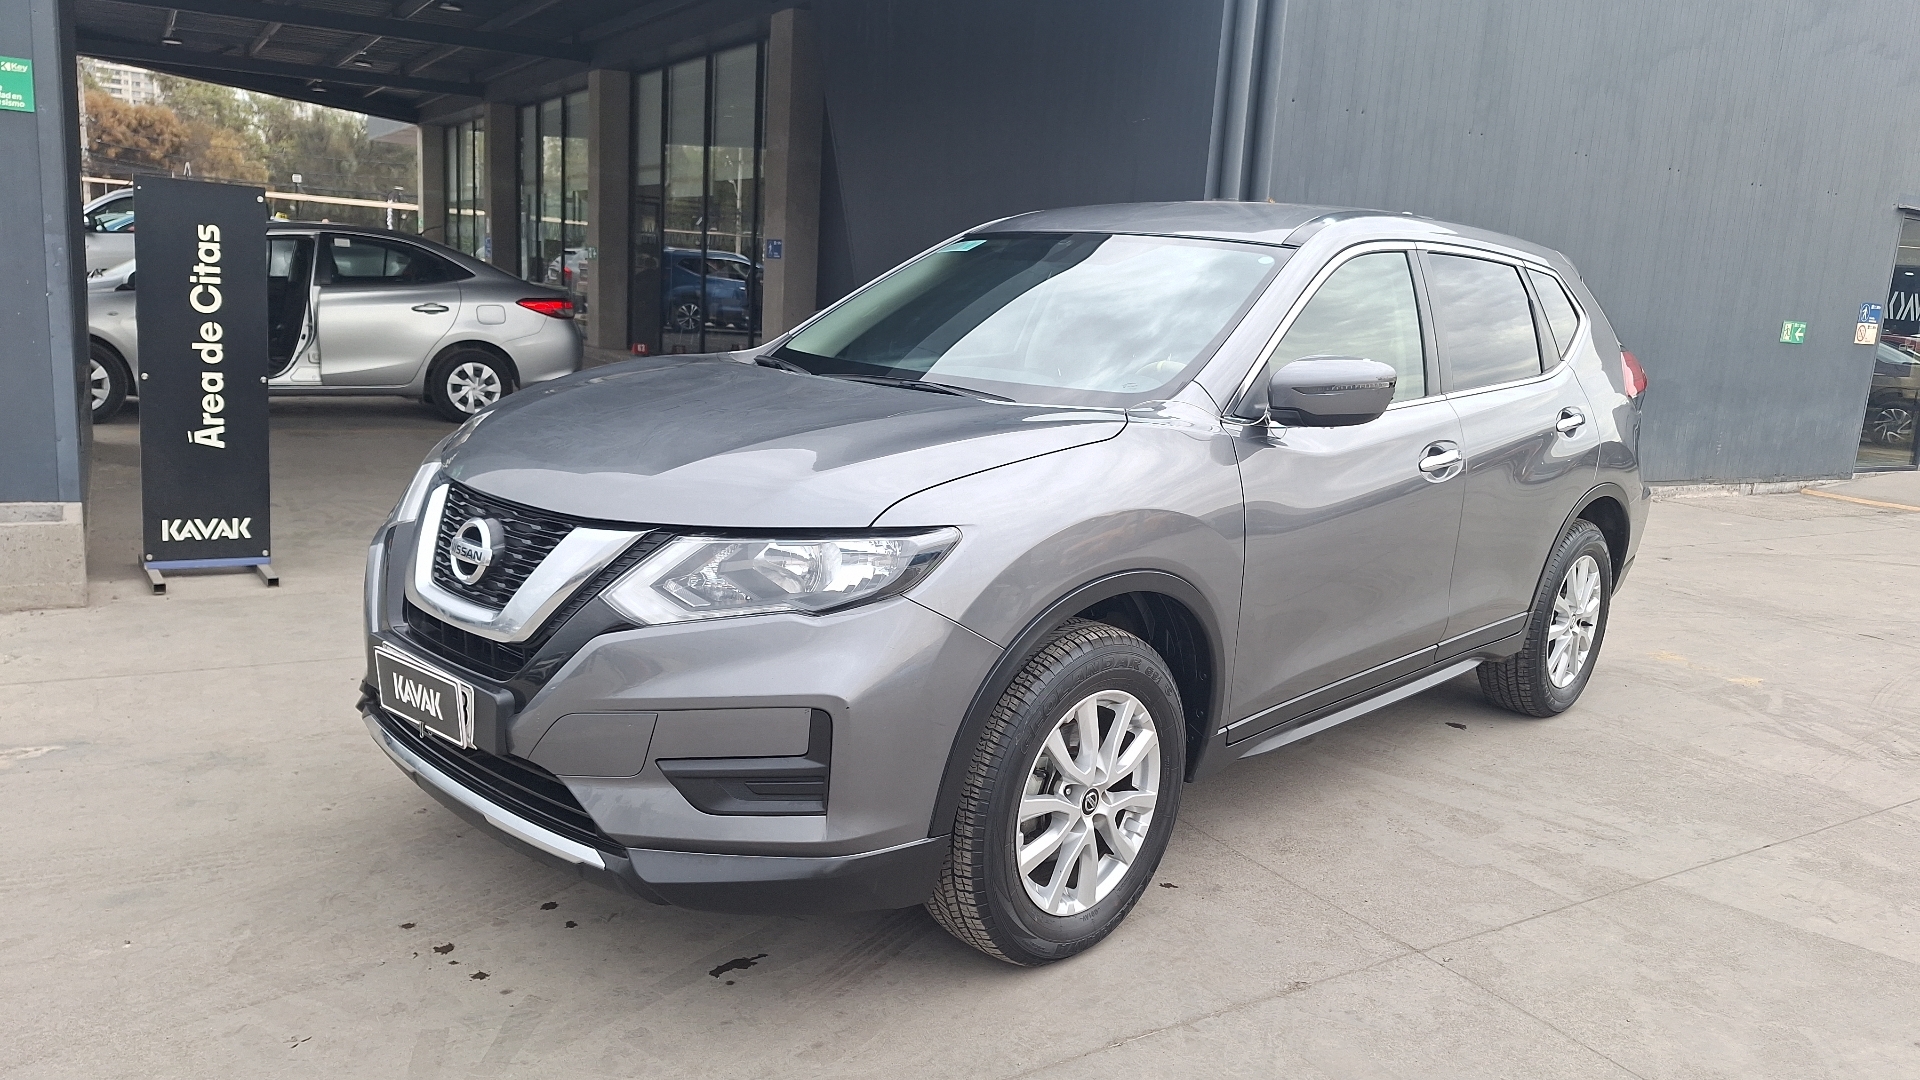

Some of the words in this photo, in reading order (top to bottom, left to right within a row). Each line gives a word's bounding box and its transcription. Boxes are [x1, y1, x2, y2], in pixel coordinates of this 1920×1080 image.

[189, 224, 222, 314] Citas
[191, 321, 224, 364] de
[187, 371, 225, 449] Área
[161, 517, 252, 542] KAVAK
[451, 540, 483, 562] NISSAN
[392, 671, 444, 721] KAVAK
